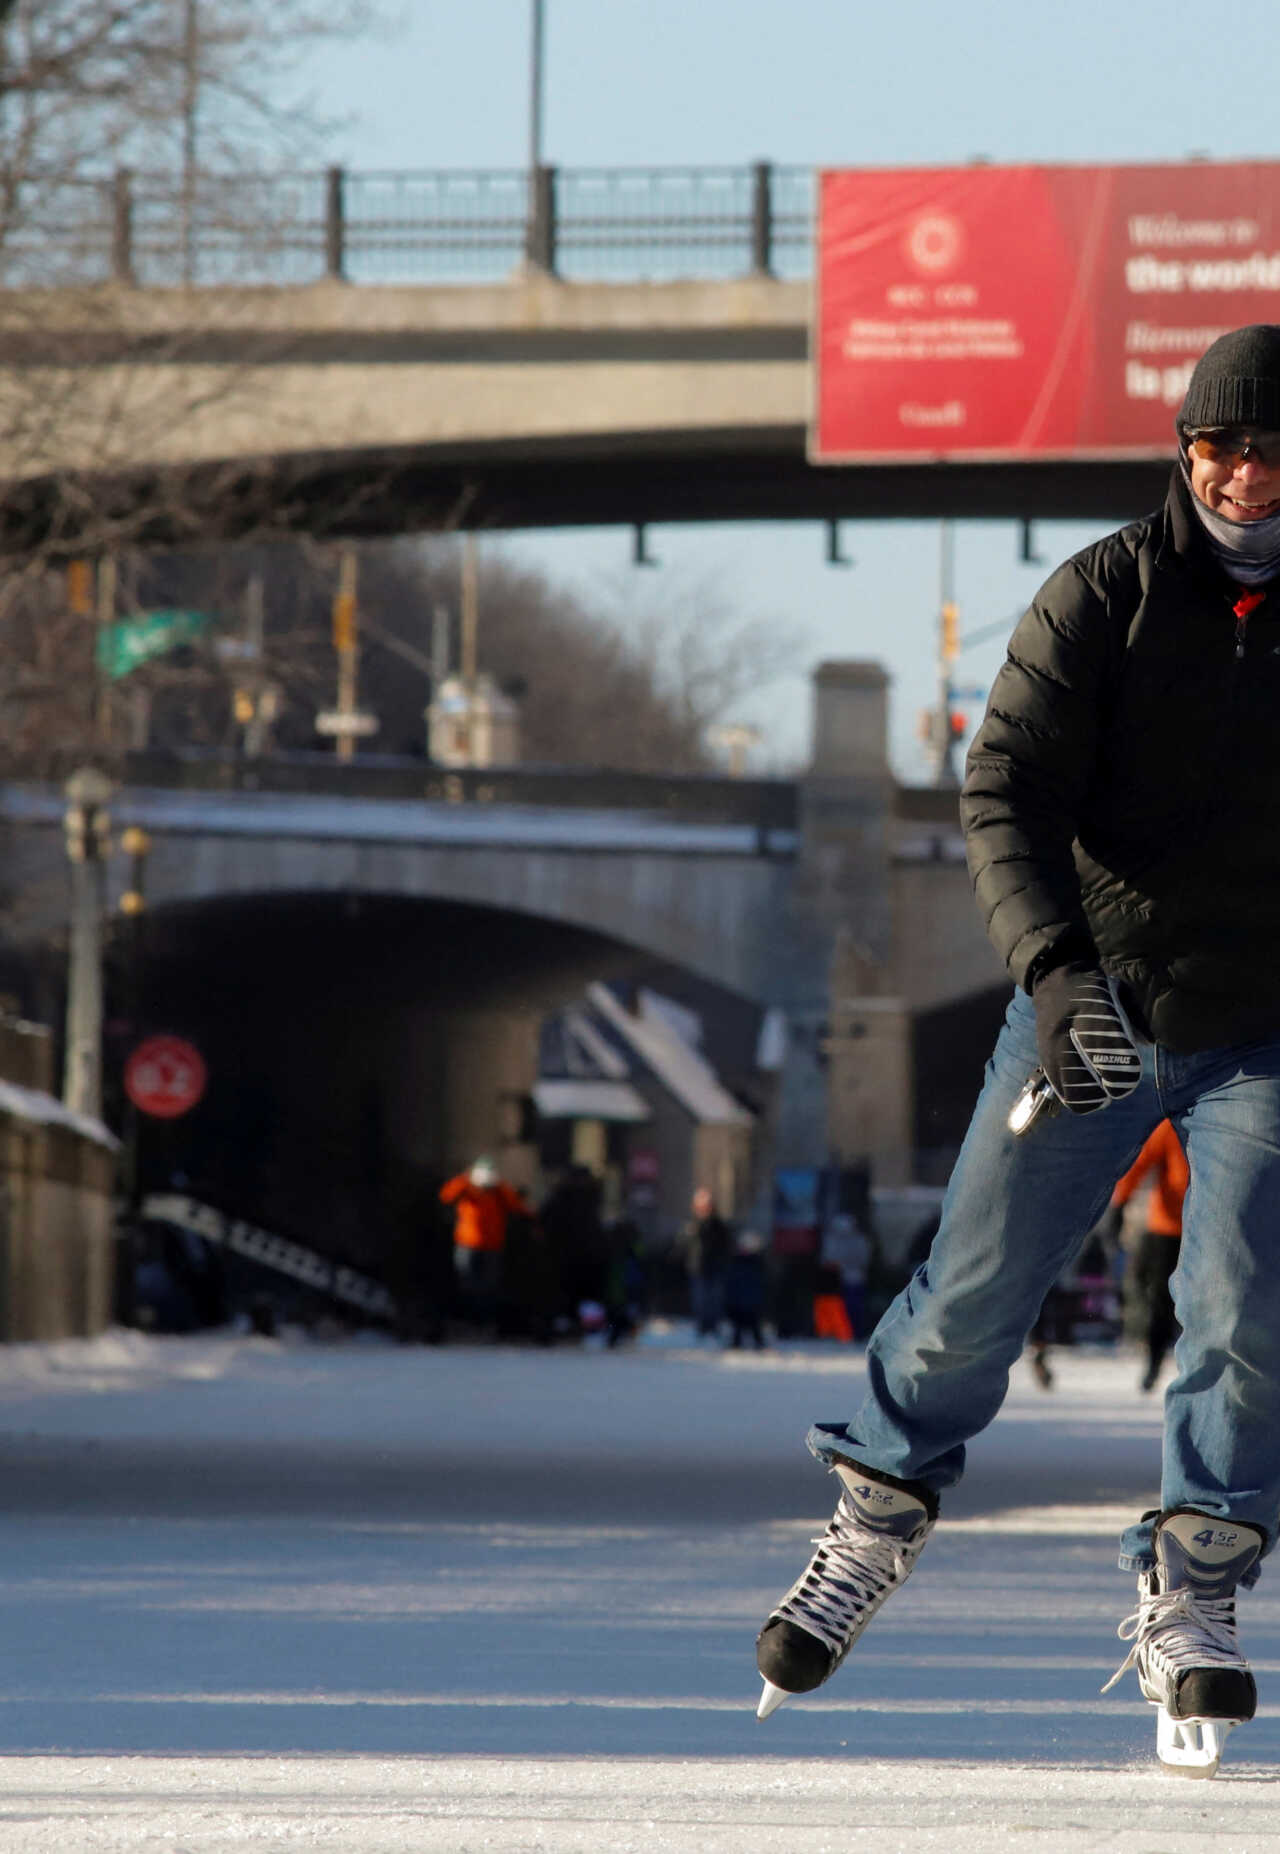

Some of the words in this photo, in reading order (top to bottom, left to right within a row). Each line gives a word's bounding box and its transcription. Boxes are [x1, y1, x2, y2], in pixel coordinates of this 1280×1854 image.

[1127, 213, 1226, 246] Welcome
[1230, 219, 1258, 246] to
[1126, 254, 1184, 293] the
